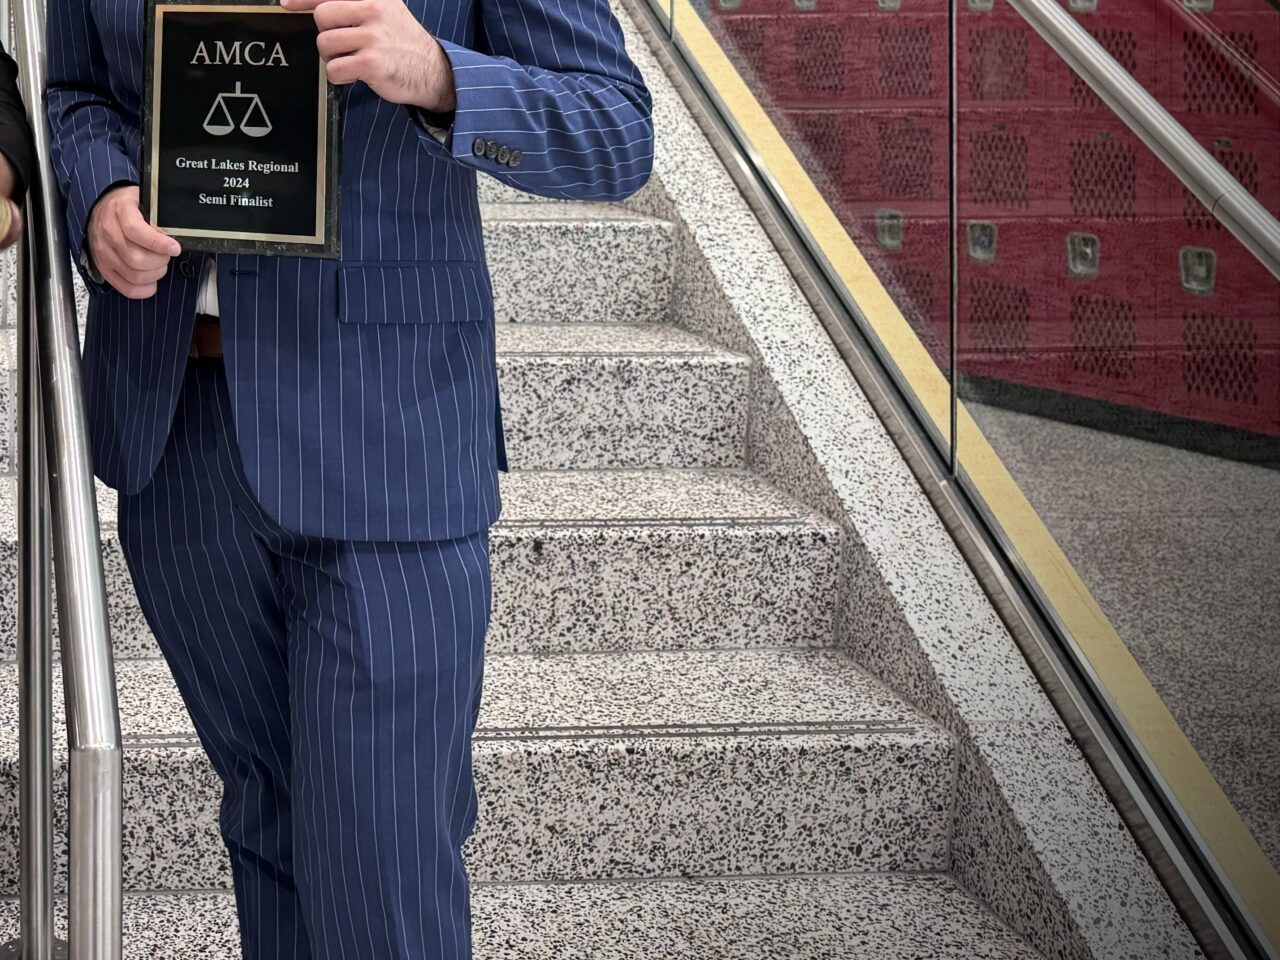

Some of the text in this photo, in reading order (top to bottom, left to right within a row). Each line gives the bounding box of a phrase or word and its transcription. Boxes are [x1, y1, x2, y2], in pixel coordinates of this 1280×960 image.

[189, 40, 289, 67] AMCA
[175, 157, 299, 174] Great Lakes Regional
[223, 177, 250, 188] 2024
[198, 193, 274, 208] Semi Finalist
